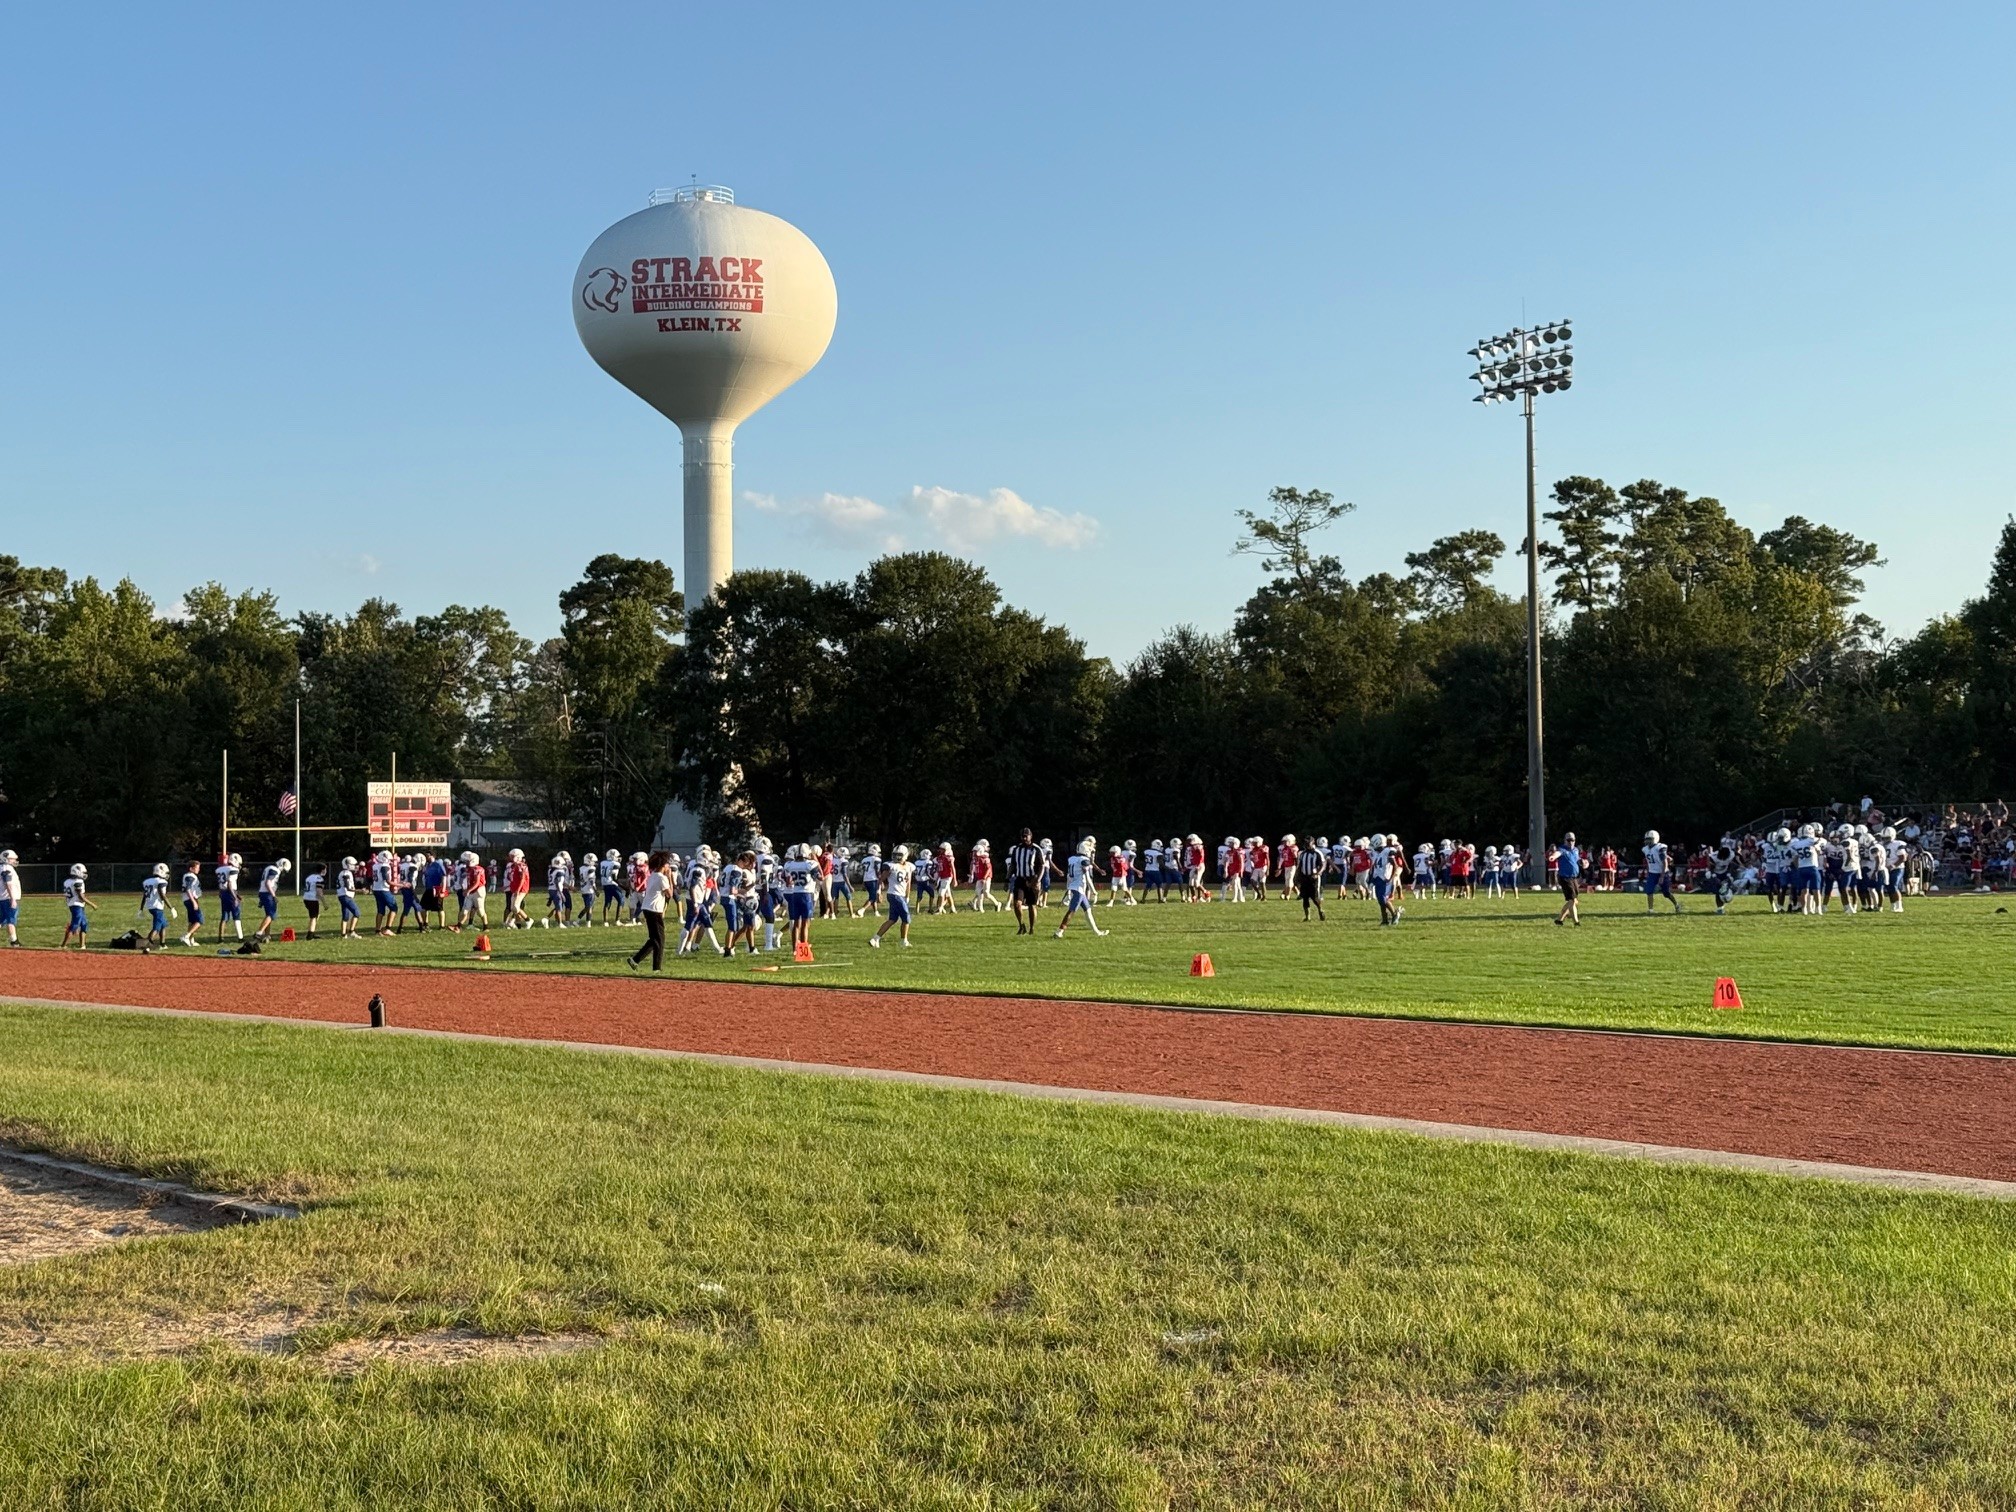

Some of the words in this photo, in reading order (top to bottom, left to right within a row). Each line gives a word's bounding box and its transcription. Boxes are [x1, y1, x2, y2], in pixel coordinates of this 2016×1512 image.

[631, 256, 764, 284] STRACK
[631, 283, 764, 300] INTERMEDIATE
[646, 300, 692, 311] BUILDING
[693, 300, 753, 311] CHAMPIONS
[1780, 850, 1792, 859] 14
[1797, 847, 1811, 859] 56
[897, 871, 909, 883] 64
[798, 946, 809, 957] 30
[1718, 983, 1735, 1000] 10
